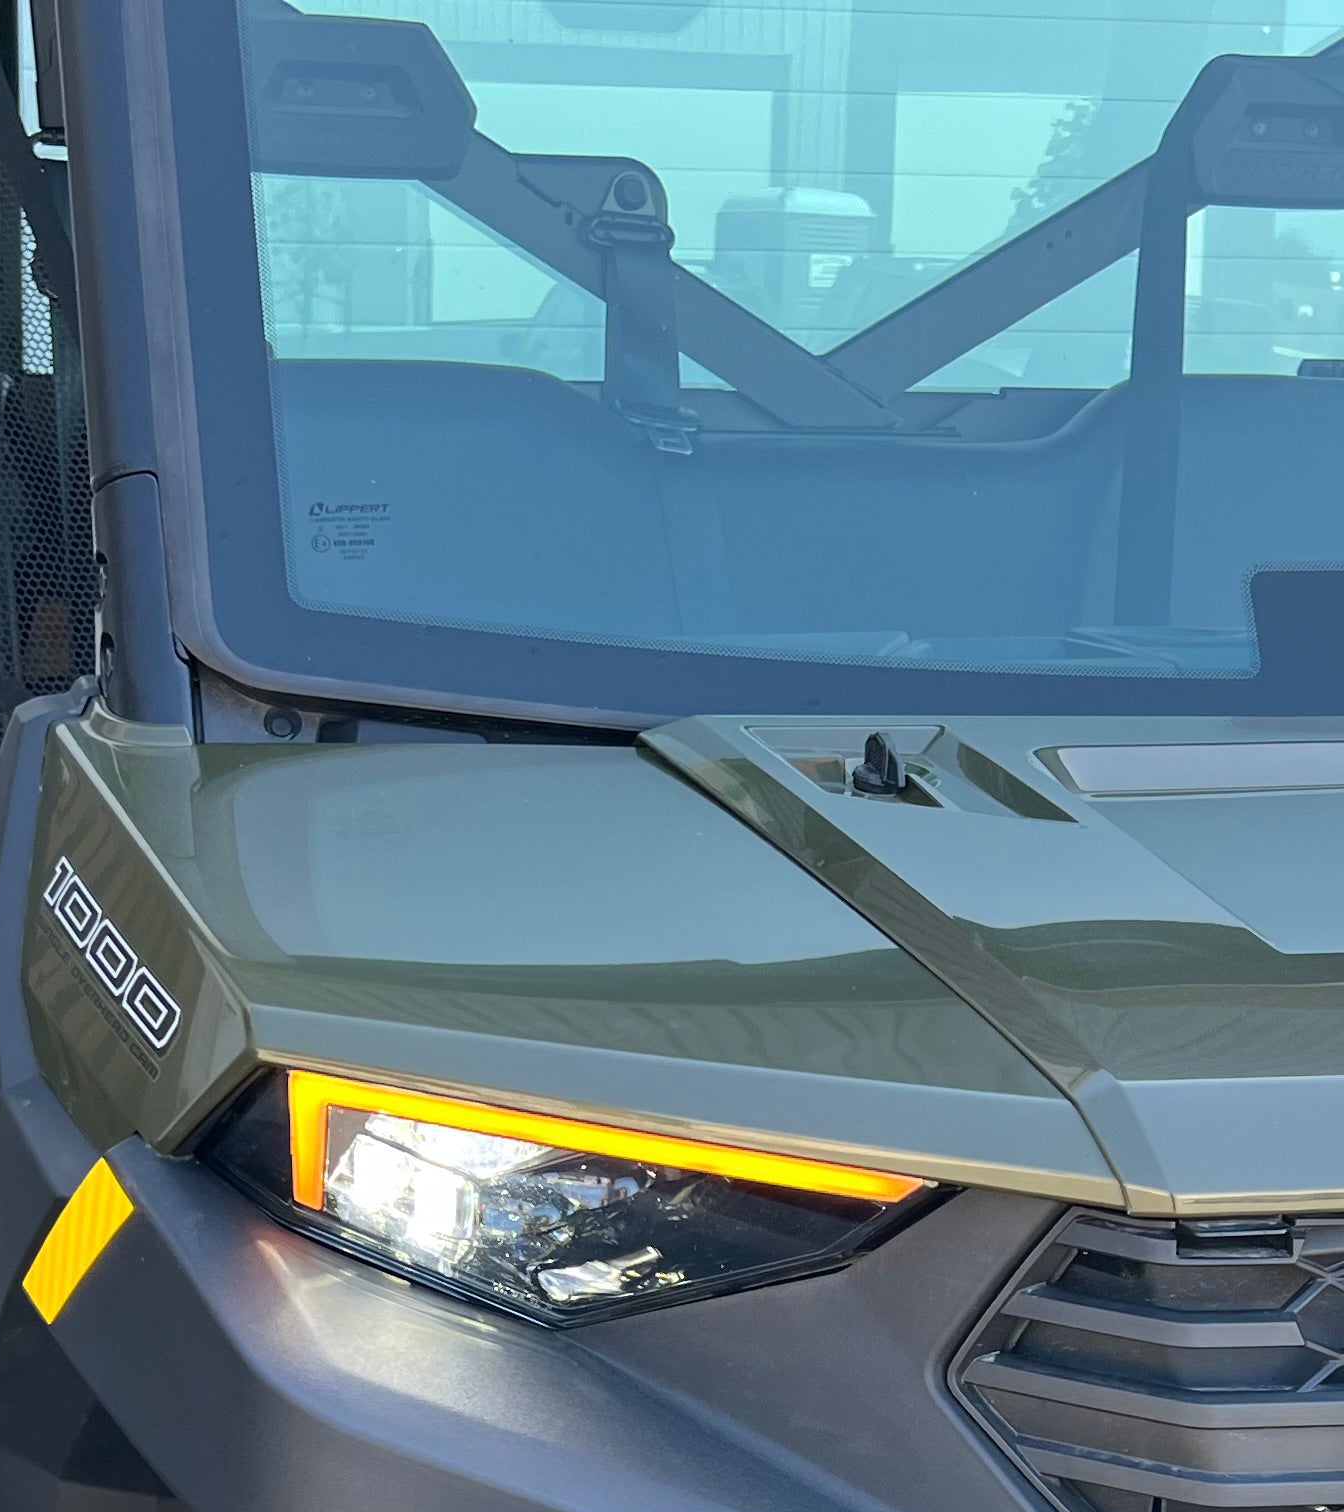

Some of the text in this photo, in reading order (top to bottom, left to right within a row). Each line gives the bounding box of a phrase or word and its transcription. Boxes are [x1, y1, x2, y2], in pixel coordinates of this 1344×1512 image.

[43, 855, 182, 1050] 1000
[69, 965, 131, 1044] OVERHEAD
[128, 1043, 159, 1081] CAM
